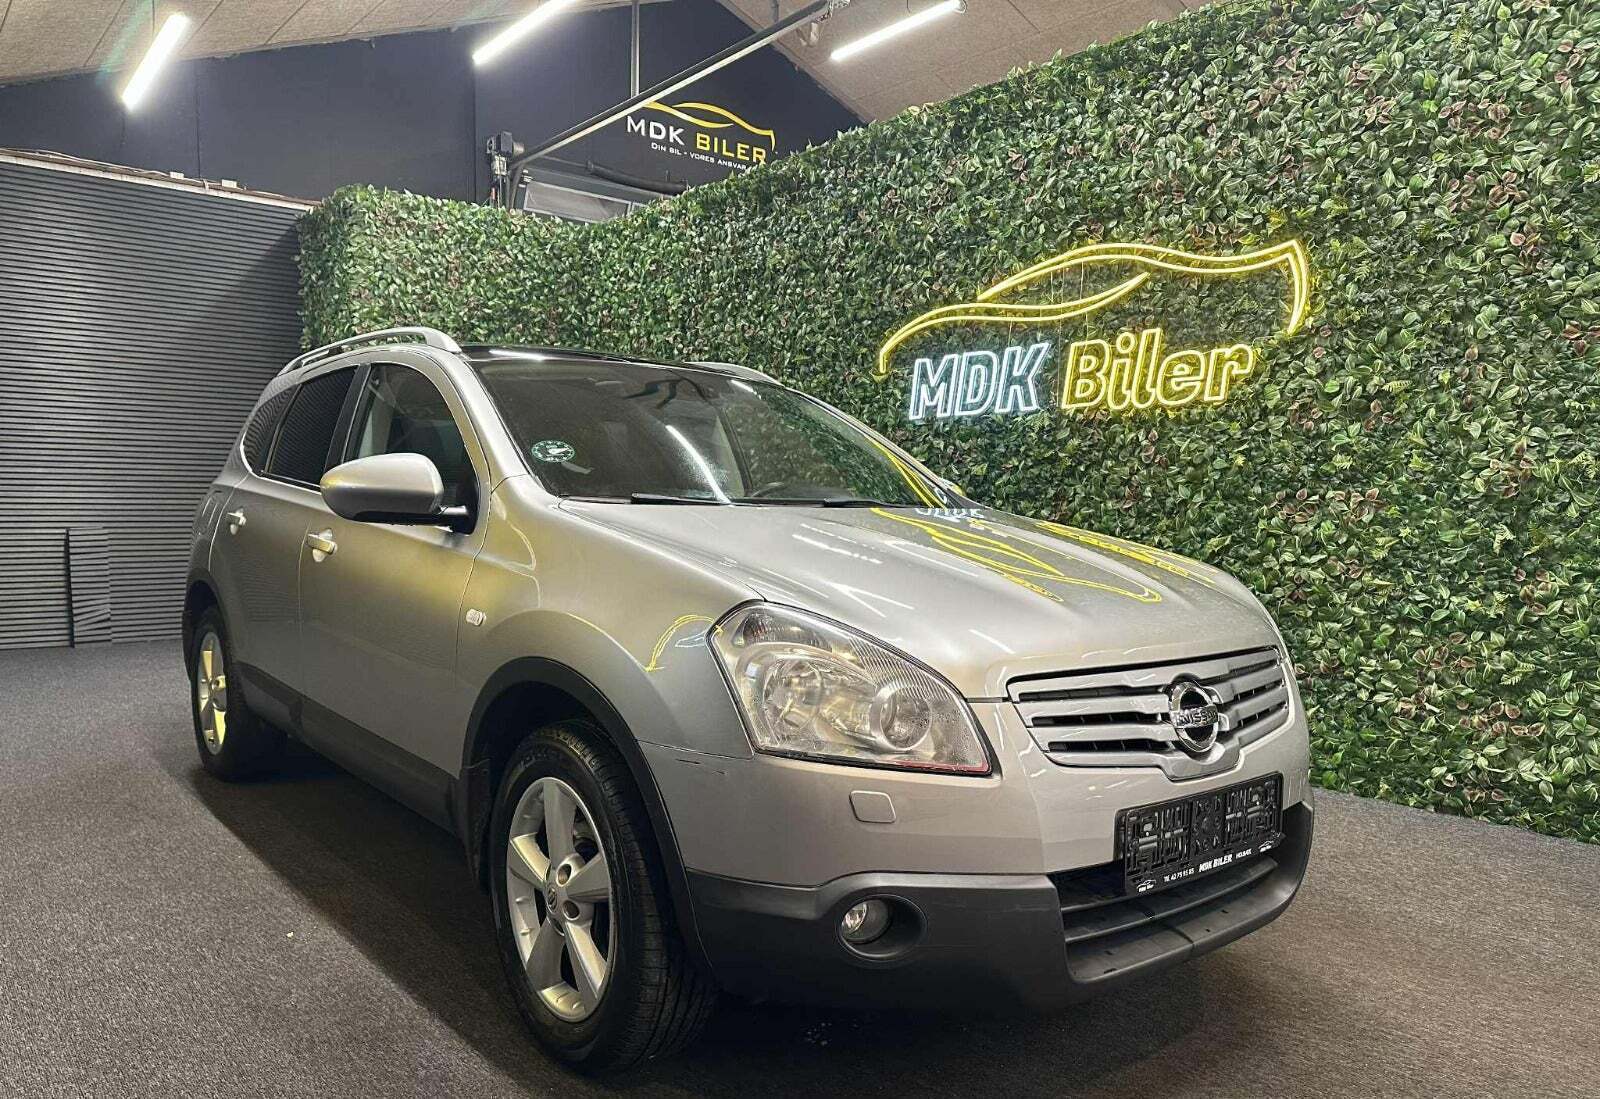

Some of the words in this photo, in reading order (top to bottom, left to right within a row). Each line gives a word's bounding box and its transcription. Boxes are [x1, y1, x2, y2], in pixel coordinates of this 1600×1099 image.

[627, 115, 685, 146] MDK
[696, 132, 766, 164] BILER
[690, 151, 715, 163] VORES
[717, 158, 747, 171] ANSVAR
[909, 341, 1050, 421] MDK
[1060, 327, 1255, 411] Biler
[1198, 860, 1213, 873] MDK
[1213, 853, 1233, 868] BILER
